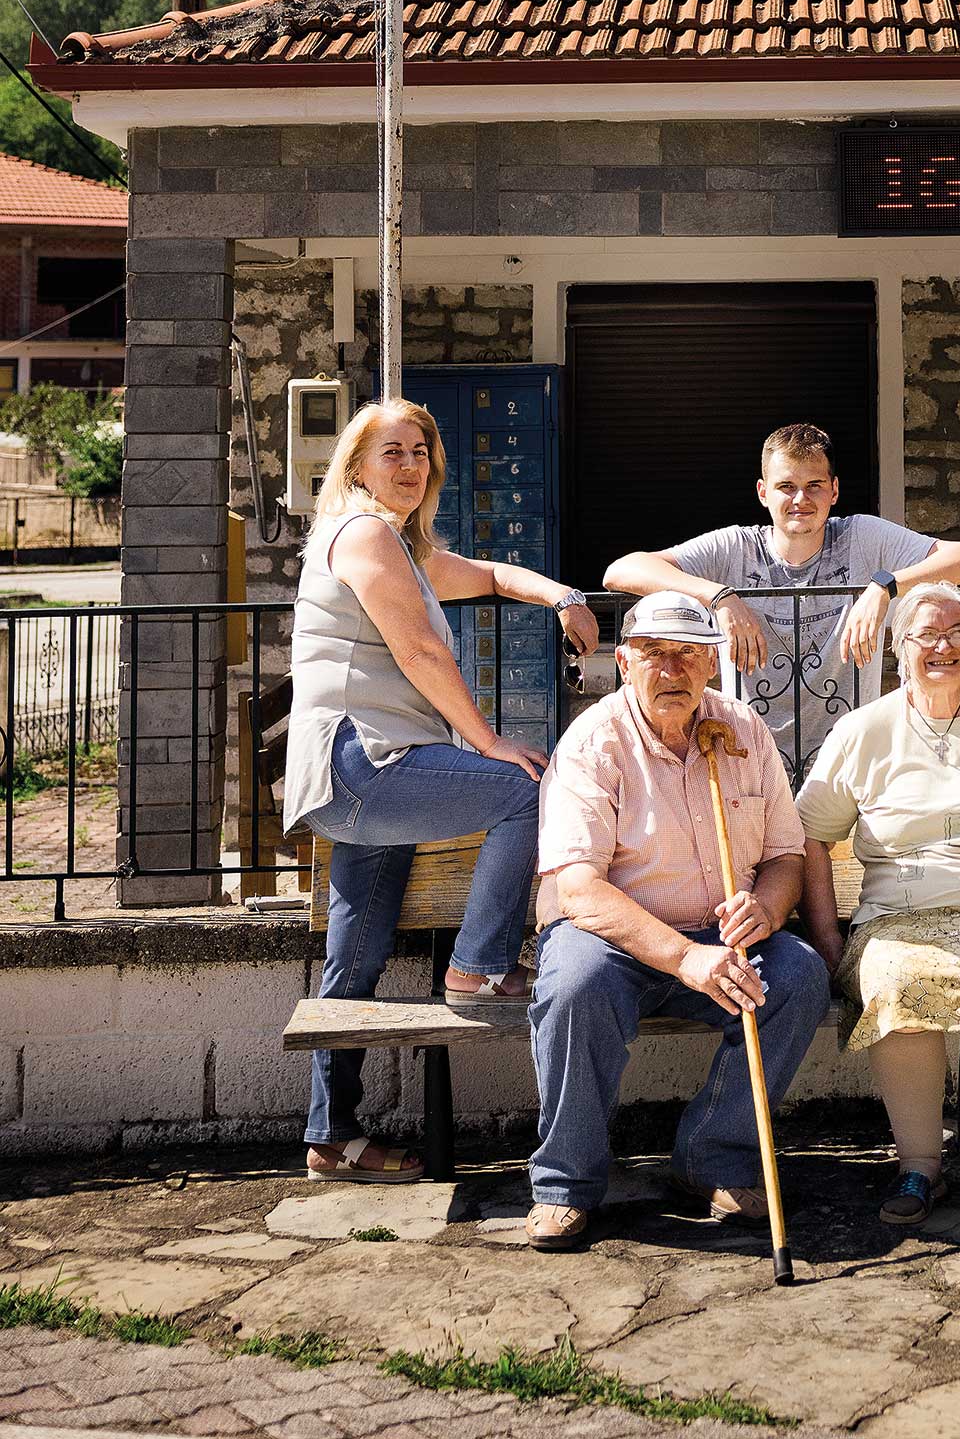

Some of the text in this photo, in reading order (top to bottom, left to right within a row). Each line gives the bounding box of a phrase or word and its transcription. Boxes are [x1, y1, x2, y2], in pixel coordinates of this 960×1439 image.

[507, 401, 518, 415] 2
[508, 435, 518, 447] 4
[510, 463, 520, 475] 6
[508, 522, 523, 535] 10
